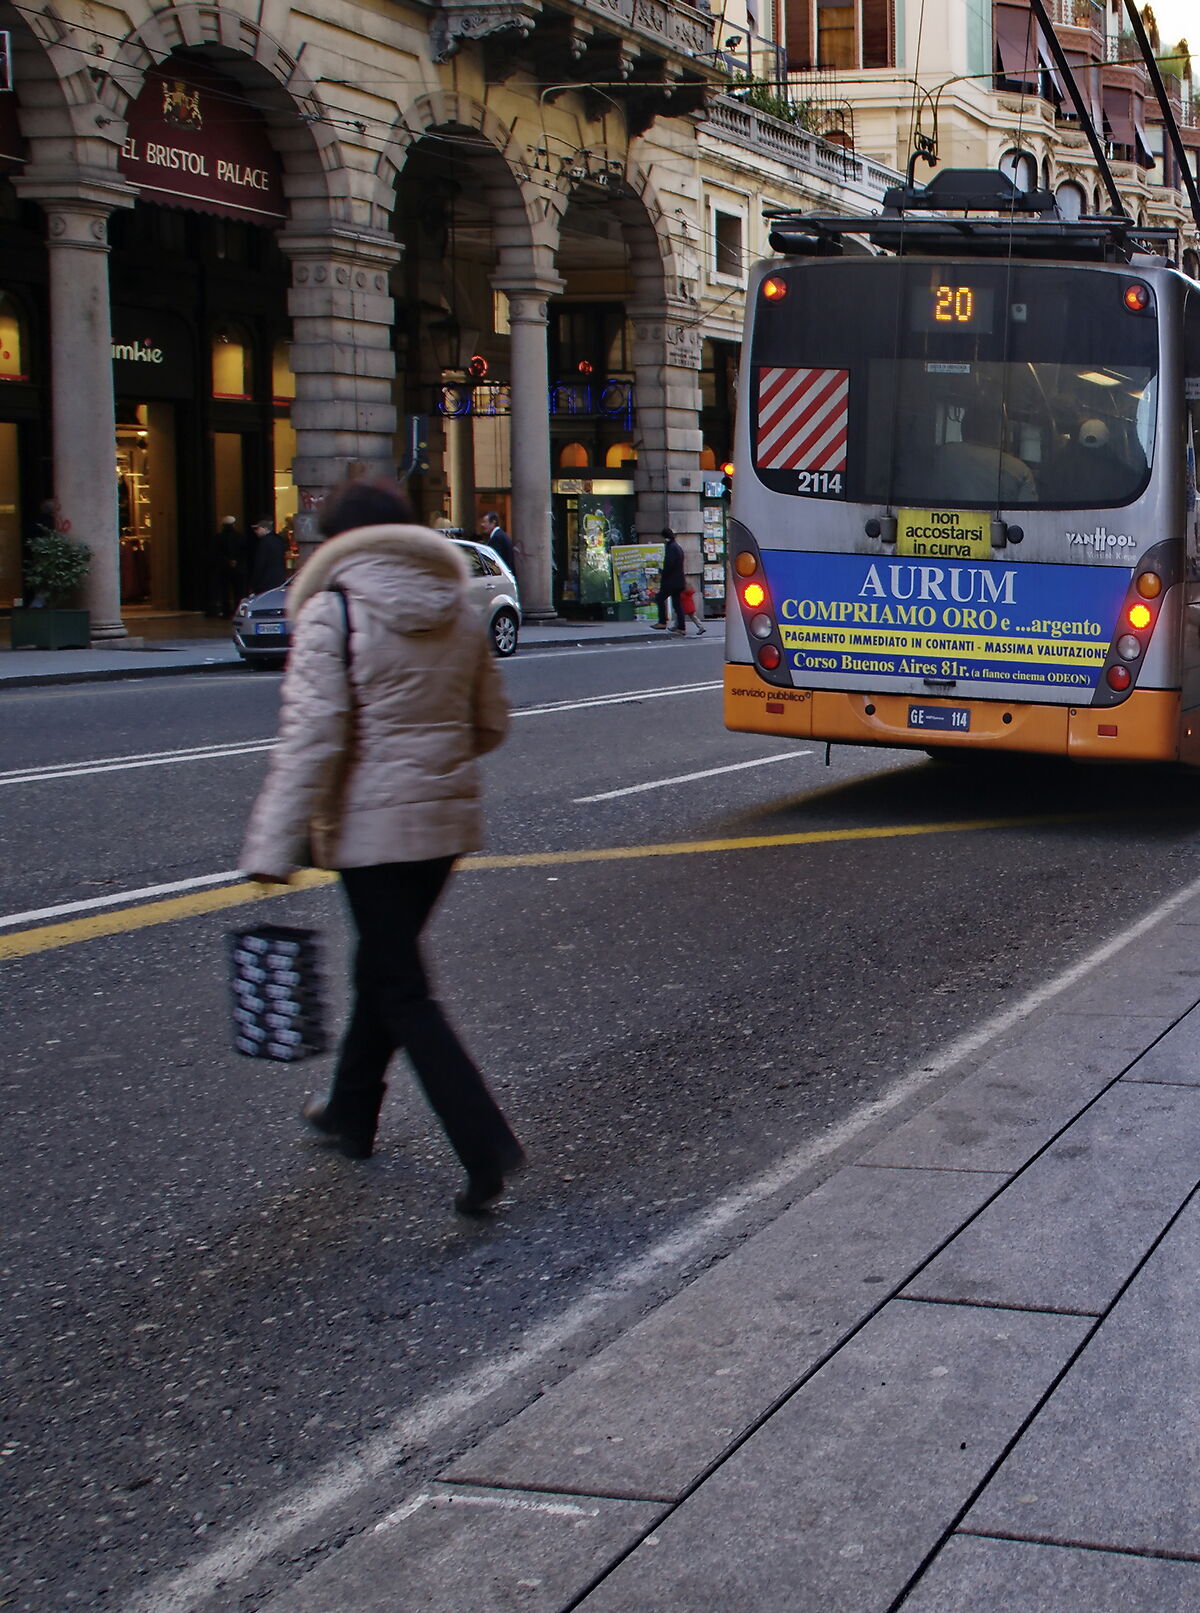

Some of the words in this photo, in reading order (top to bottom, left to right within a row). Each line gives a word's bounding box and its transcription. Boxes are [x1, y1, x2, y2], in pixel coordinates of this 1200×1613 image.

[121, 137, 140, 161] EL
[146, 142, 209, 175] BRISTOL
[217, 159, 270, 191] PALACE
[935, 286, 972, 321] 20
[111, 336, 163, 364] imkie
[797, 471, 842, 494] 2114
[931, 512, 960, 525] non
[905, 526, 983, 541] accostarsi
[913, 539, 927, 555] in
[929, 543, 971, 557] curva
[858, 563, 1018, 604] AURUM
[781, 598, 937, 627] COMPRIAMO
[942, 606, 998, 630] ORO
[1000, 617, 1011, 631] e
[784, 630, 846, 644] PAGAMENTO
[849, 634, 908, 648] IMMEDIATO
[911, 637, 922, 649] IN
[925, 639, 974, 652] CONTANTI
[984, 641, 1034, 655] MASSIMA
[1037, 644, 1108, 659] VALUTAZIONE
[793, 652, 837, 669] Corso
[841, 654, 895, 673] Buenos
[898, 657, 938, 675] Aires
[940, 660, 970, 677] 81r.
[971, 668, 981, 679] (a
[982, 667, 1011, 681] fianco
[1012, 669, 1046, 682] cinema
[1047, 672, 1091, 686] ODEON)
[731, 687, 766, 698] servizio
[767, 691, 806, 702] pubblico
[910, 709, 925, 724] GE
[951, 711, 967, 727] 114
